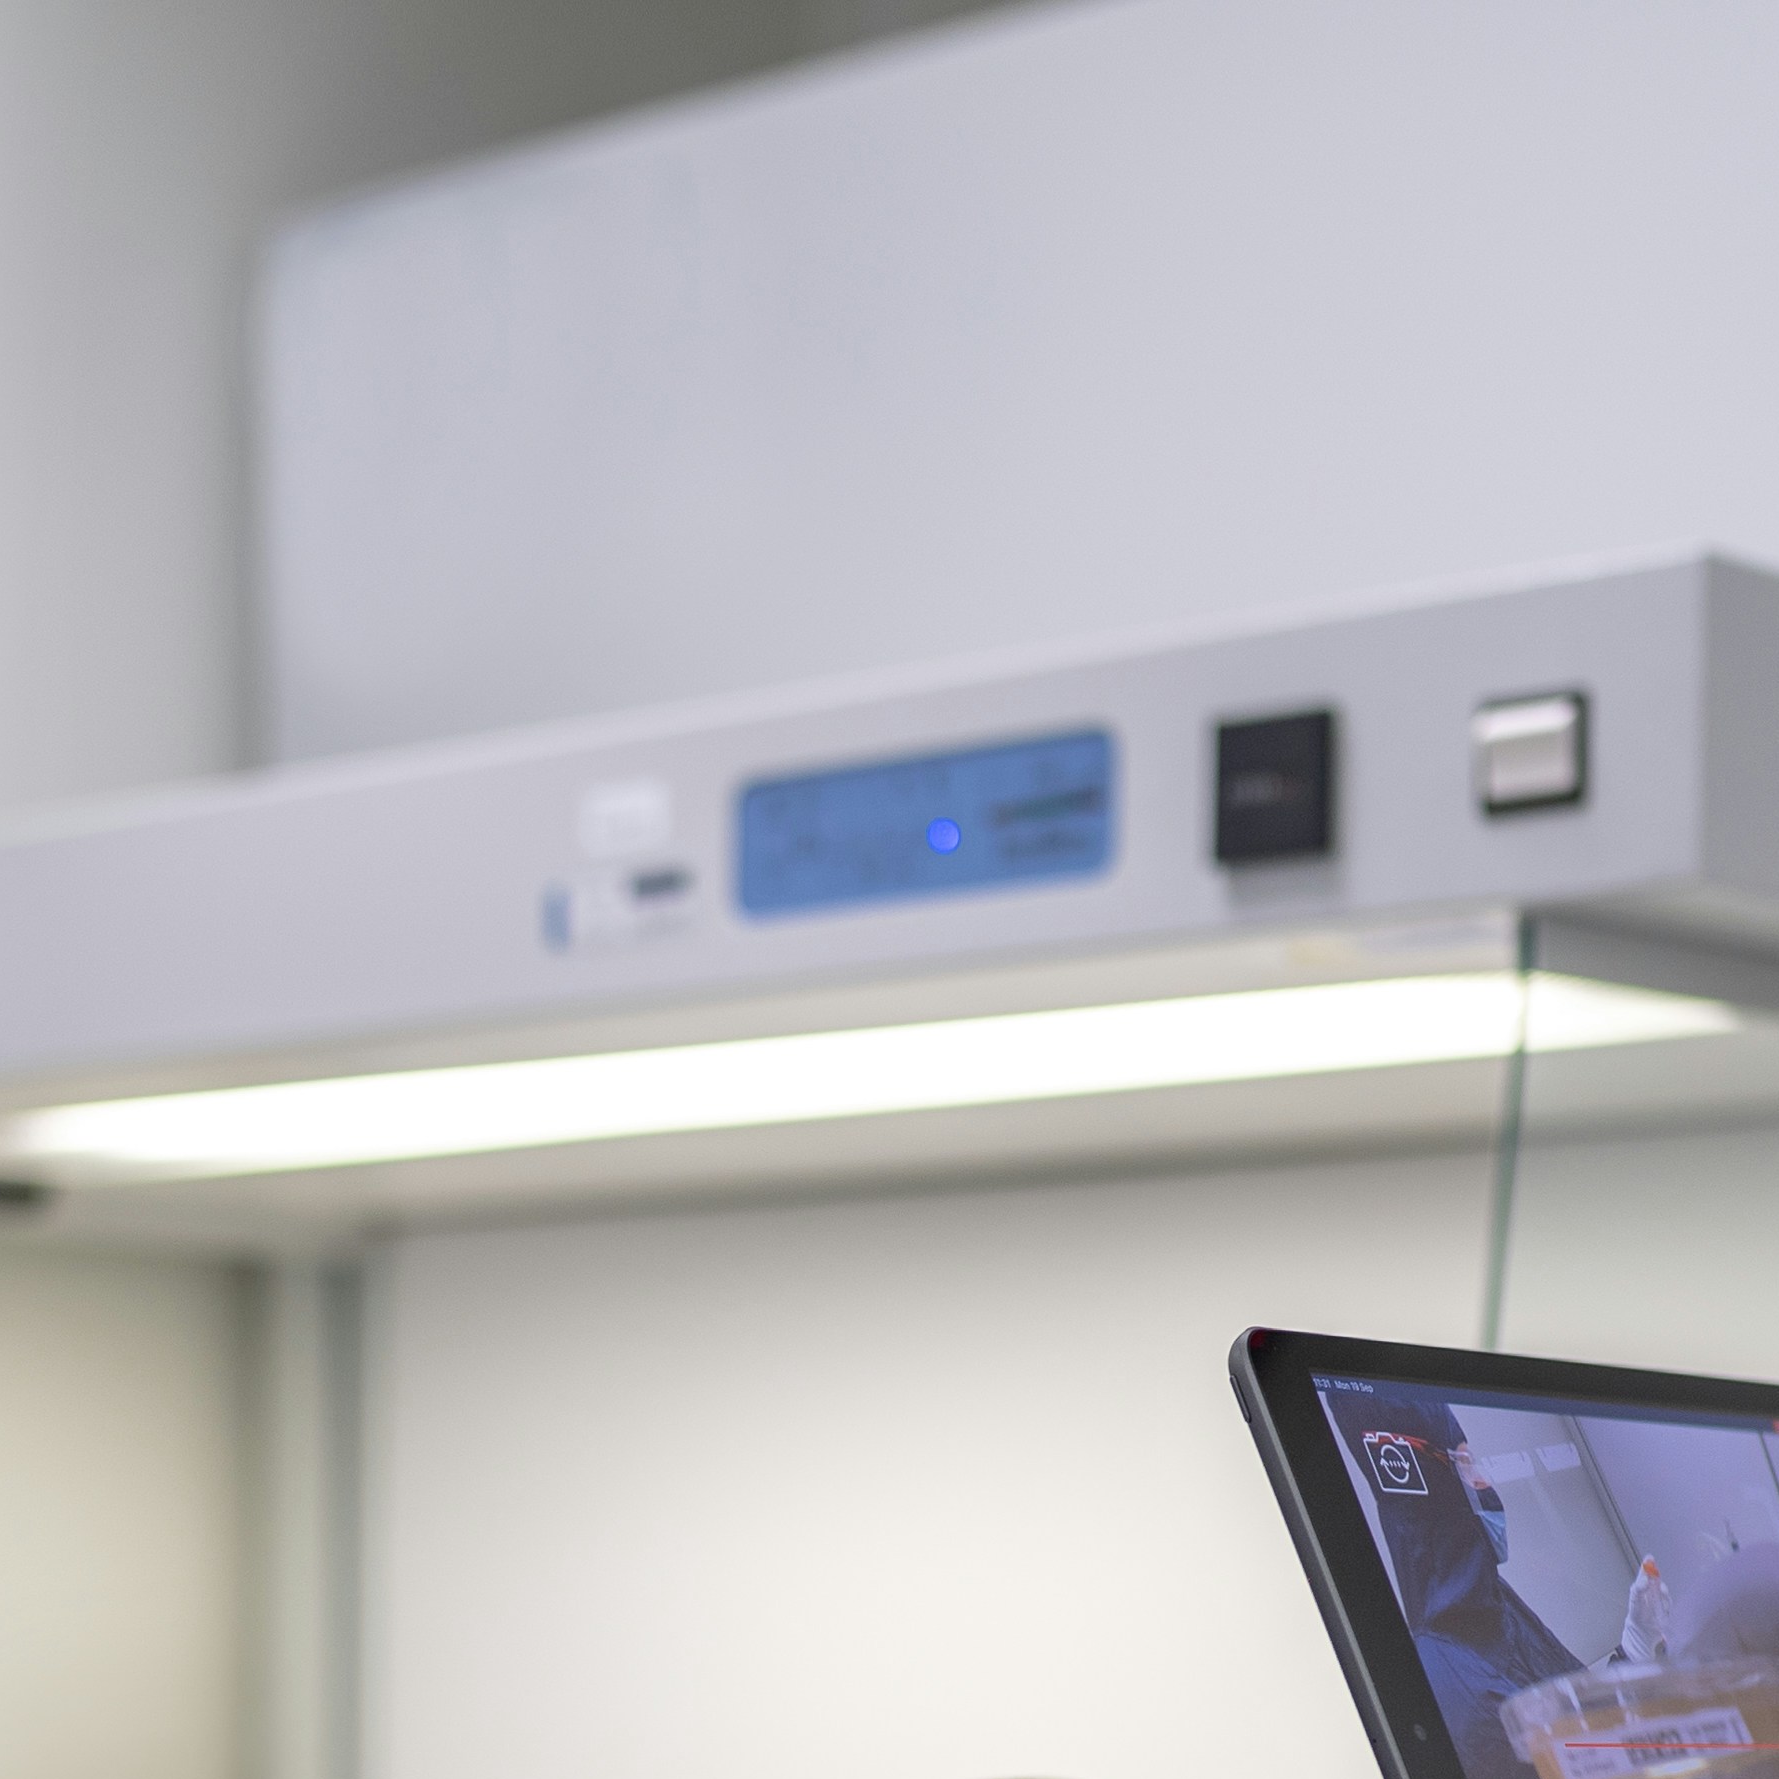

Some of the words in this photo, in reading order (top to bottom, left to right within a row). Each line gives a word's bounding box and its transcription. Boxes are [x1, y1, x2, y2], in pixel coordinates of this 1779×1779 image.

[1334, 1380, 1351, 1390] Mon
[1350, 1381, 1360, 1391] 19
[1359, 1382, 1374, 1393] Sep
